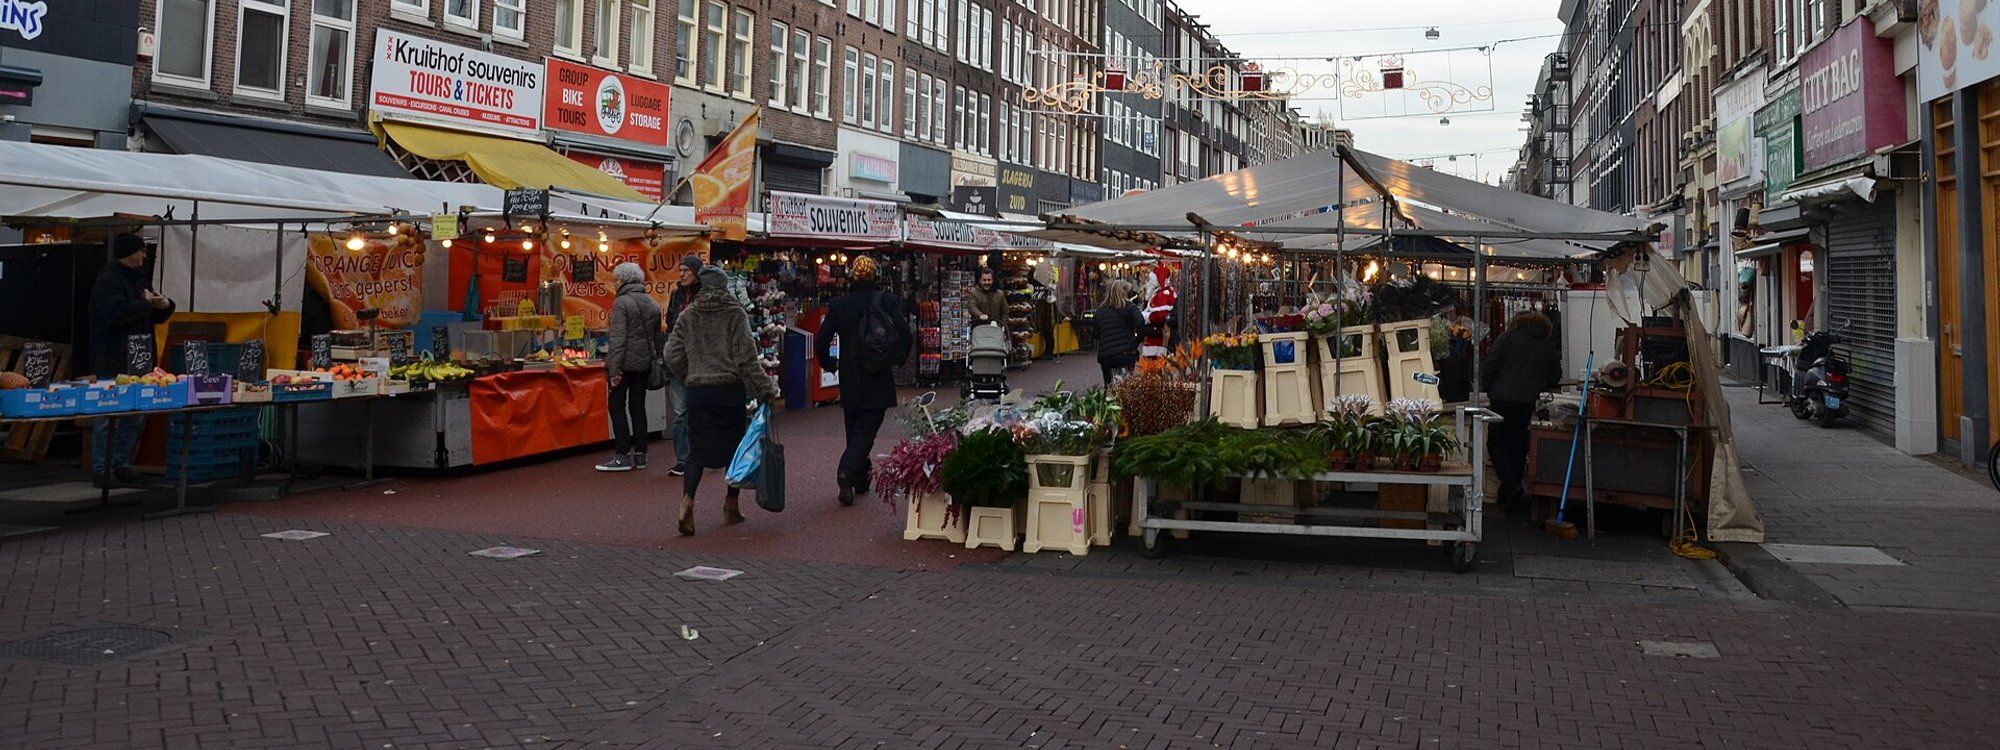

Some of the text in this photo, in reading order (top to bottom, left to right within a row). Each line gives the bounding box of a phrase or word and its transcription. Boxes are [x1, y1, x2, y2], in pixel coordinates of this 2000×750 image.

[395, 38, 536, 89] Kruithof souvenirs
[560, 67, 589, 87] GROUP
[1803, 65, 1829, 115] CITY
[1831, 48, 1860, 103] BAG
[410, 70, 514, 110] TOURS & TICKETS
[562, 88, 583, 107] BIKE
[378, 94, 407, 107] SOUVENIRS
[630, 94, 662, 112] LUGGAGE
[557, 107, 587, 127] TOURS
[630, 113, 661, 131] STORAGE
[1002, 169, 1034, 189] SLAGERIJ
[775, 195, 807, 216] Kruithof
[978, 203, 986, 214] 91
[1010, 195, 1026, 211] ZUID
[810, 202, 868, 234] souvenirs
[315, 255, 380, 275] ORANGE
[356, 276, 413, 300] geperst
[564, 280, 607, 296] vers
[381, 306, 409, 319] beker
